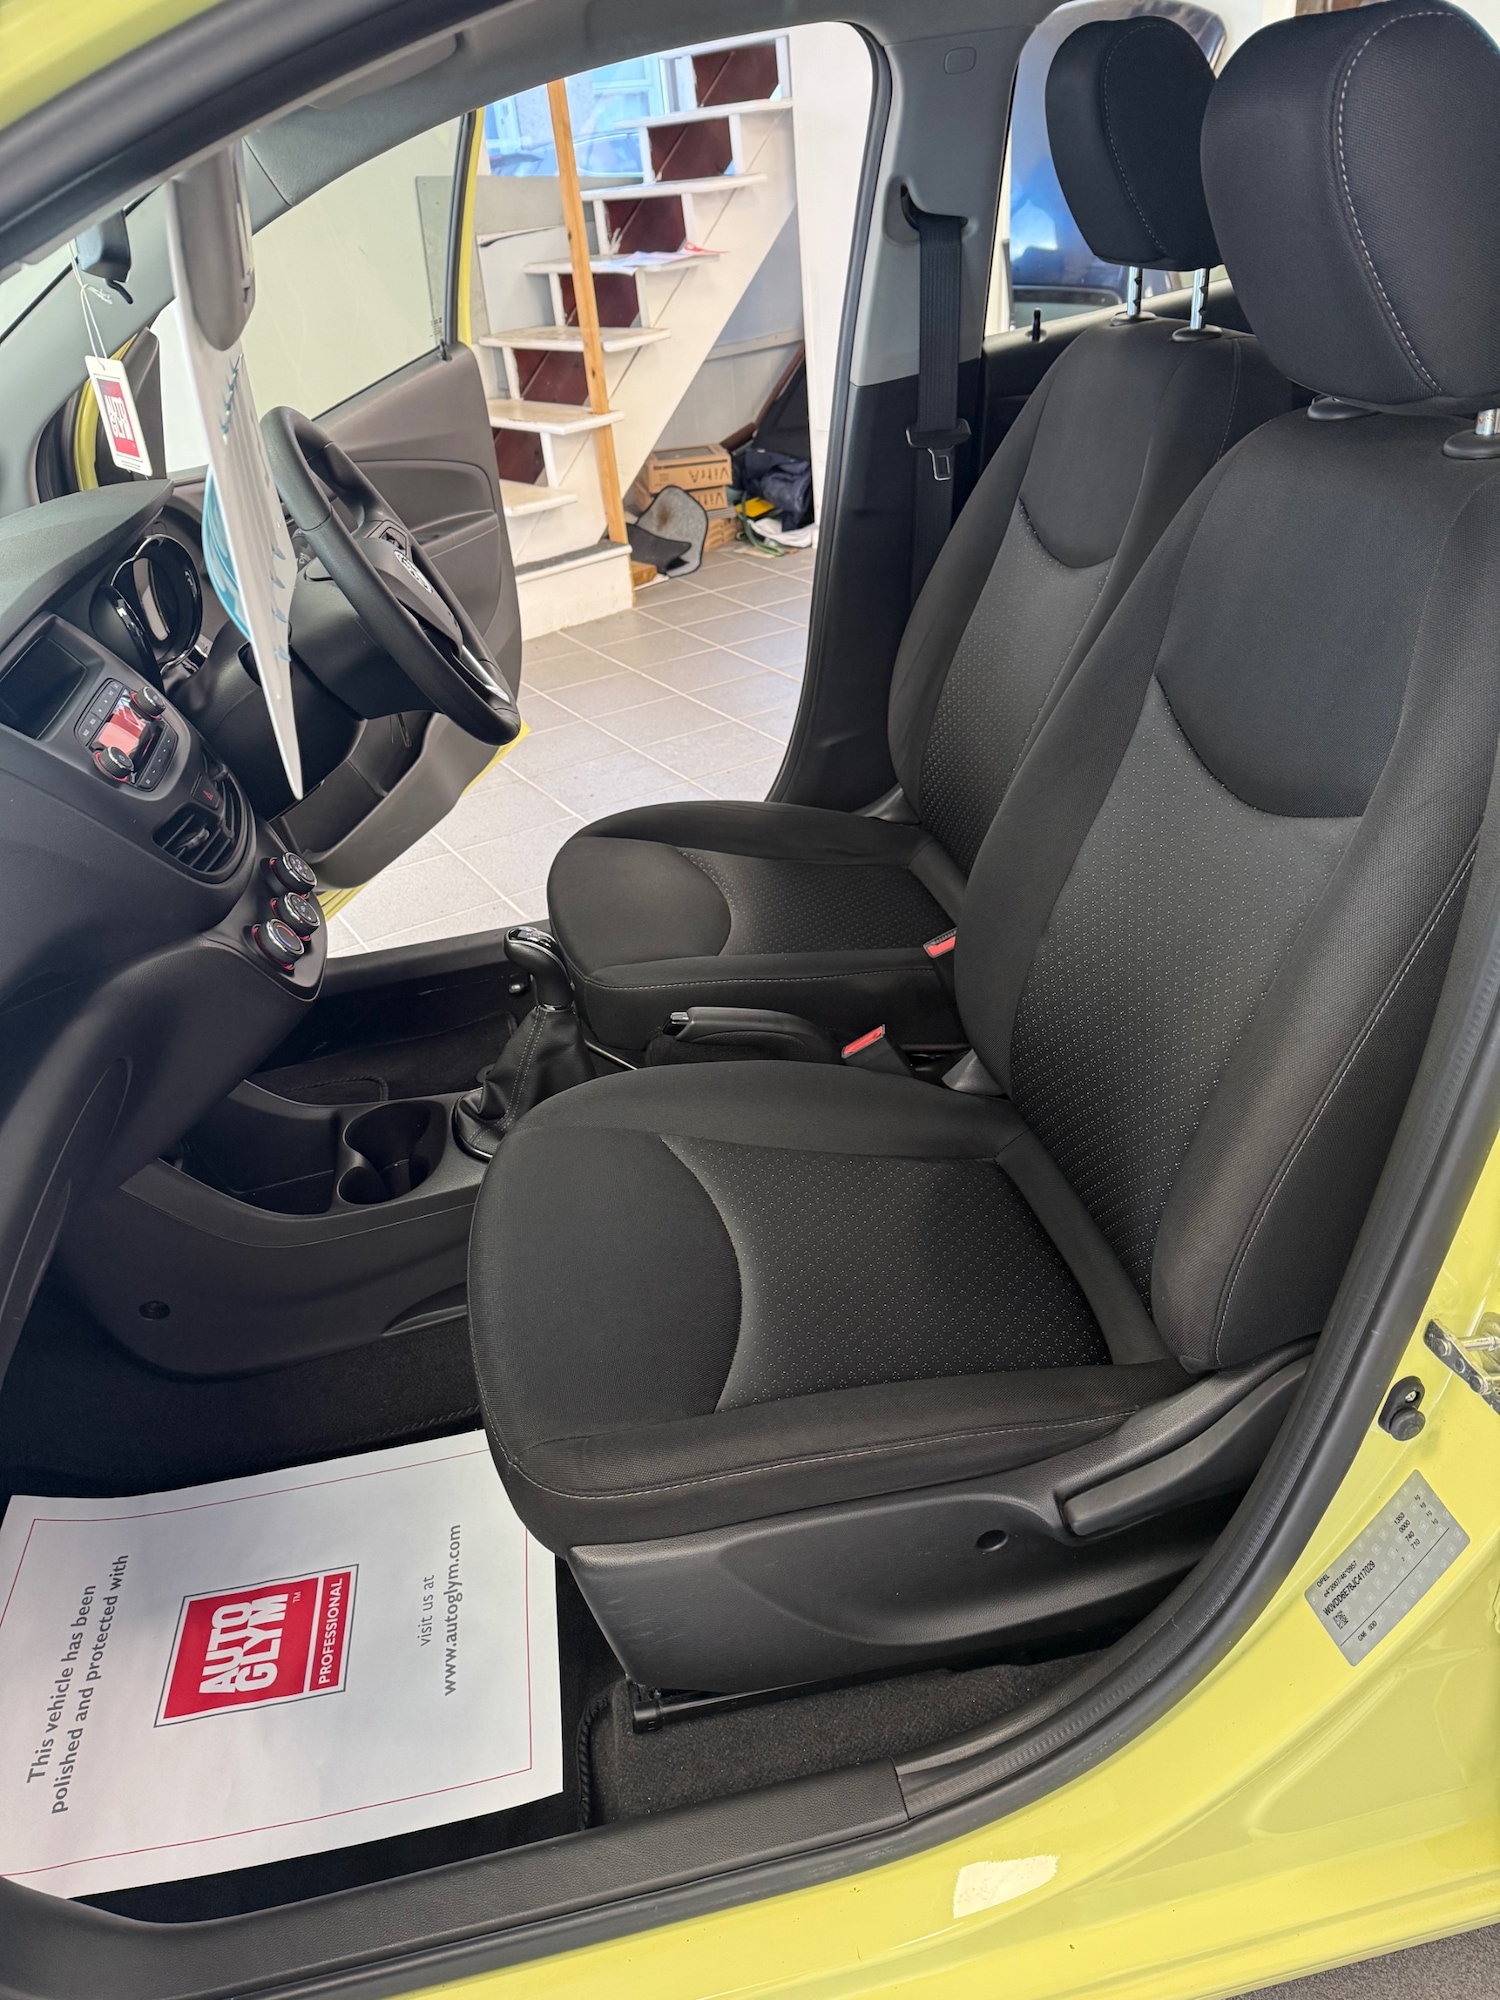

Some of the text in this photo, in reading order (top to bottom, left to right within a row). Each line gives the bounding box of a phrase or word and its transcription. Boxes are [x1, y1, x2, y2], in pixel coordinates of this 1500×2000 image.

[688, 467, 730, 483] VitrA
[1394, 1512, 1405, 1525] 1353
[1405, 1530, 1415, 1542] 740
[1410, 1538, 1420, 1550] 710
[416, 1574, 434, 1647] visit us at
[443, 1524, 463, 1697] www.autoglym.com
[1316, 1573, 1330, 1588] OPEL
[198, 1602, 252, 1693] AUTO
[235, 1594, 289, 1692] GLYM
[318, 1577, 343, 1685] PROFESSIONAL
[26, 1585, 97, 1783] This vehicle has been
[51, 1555, 129, 1814] polished and protected with
